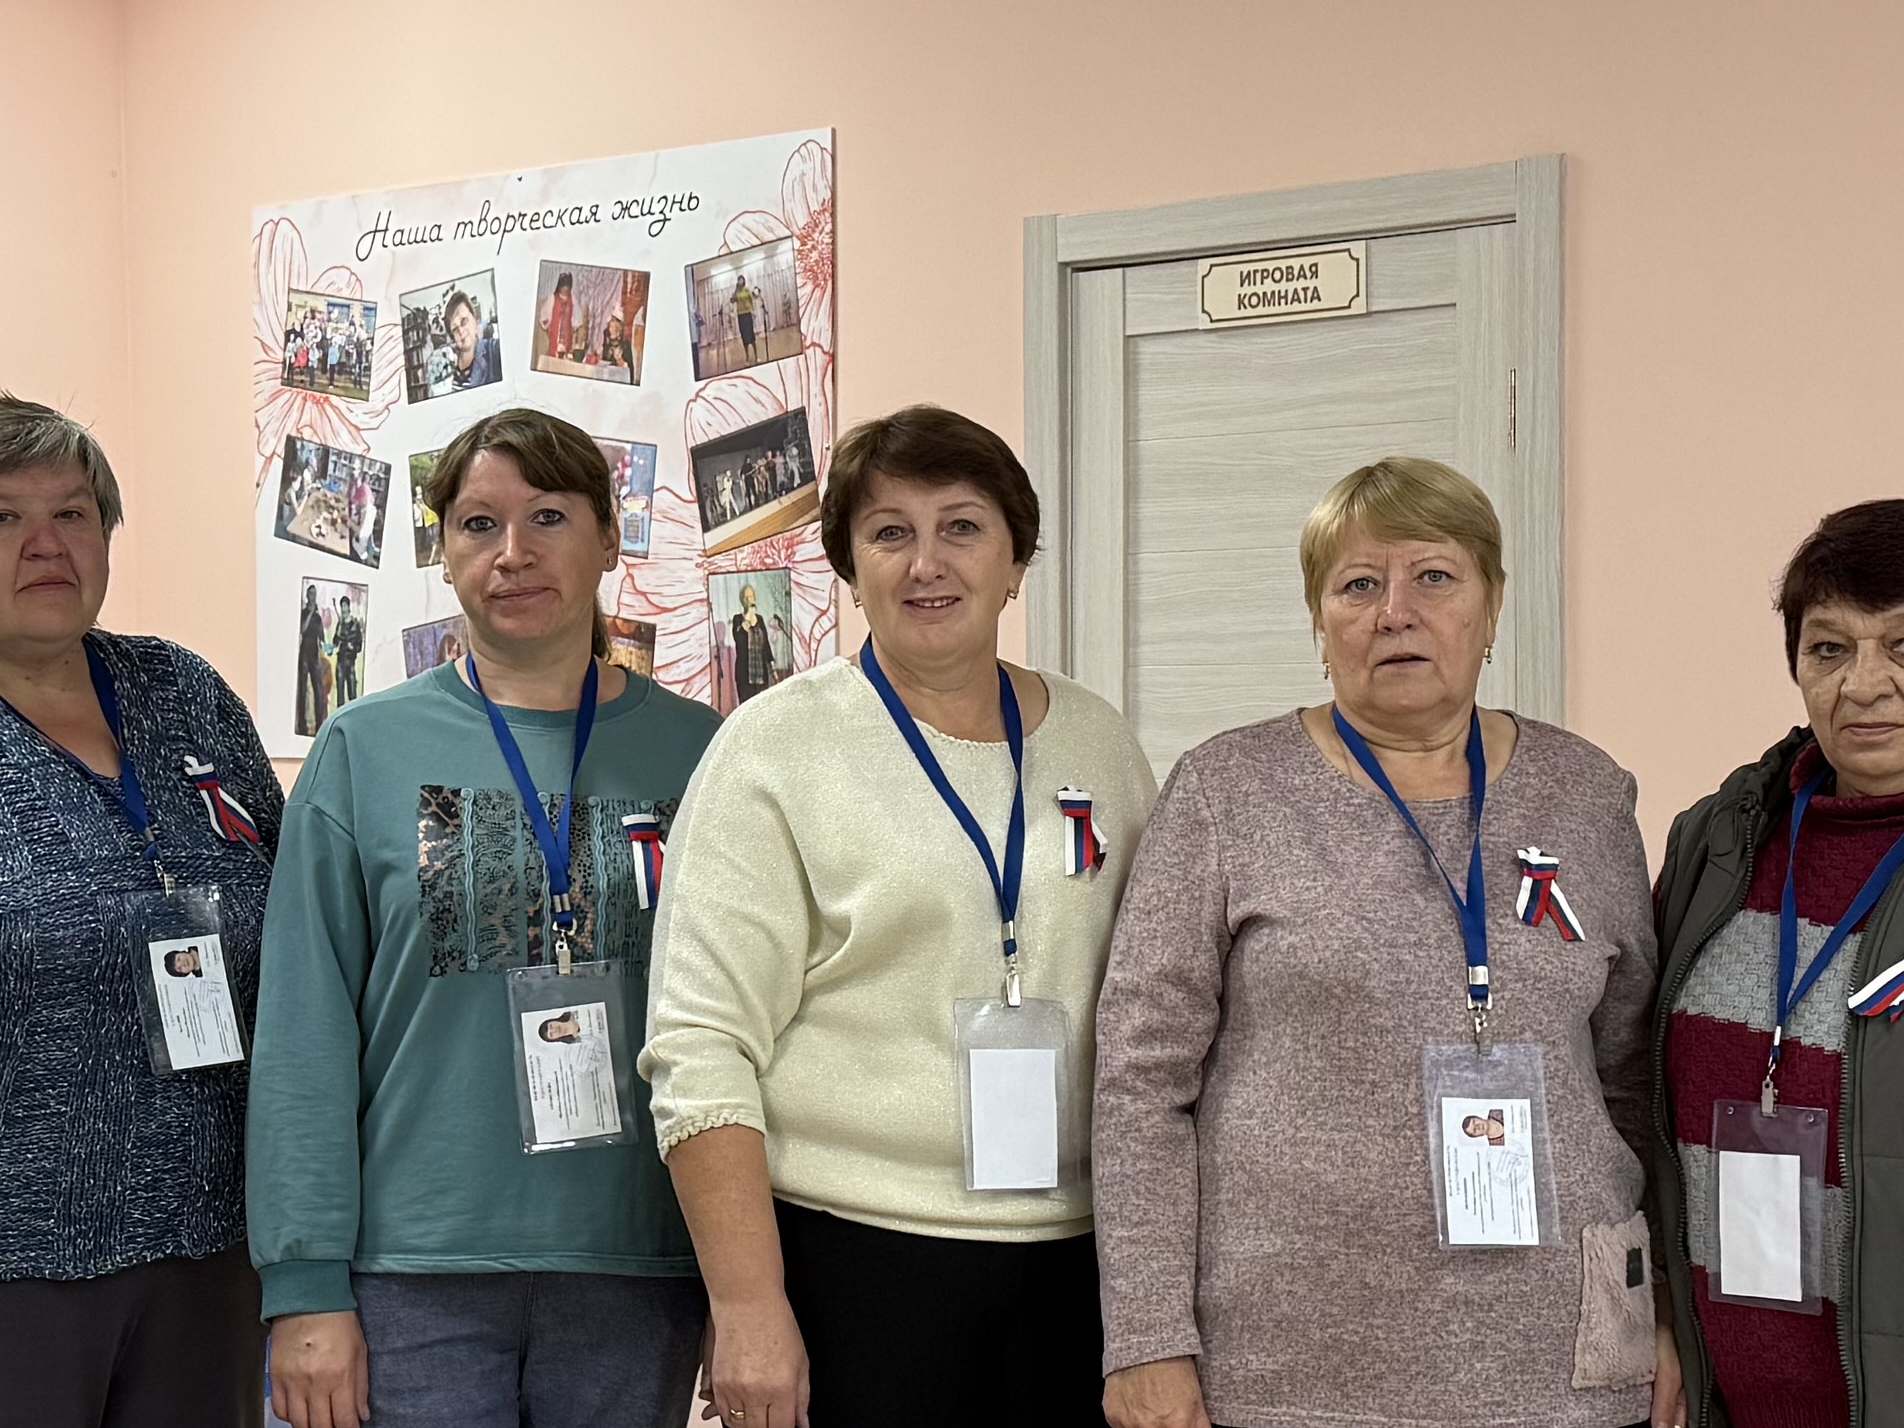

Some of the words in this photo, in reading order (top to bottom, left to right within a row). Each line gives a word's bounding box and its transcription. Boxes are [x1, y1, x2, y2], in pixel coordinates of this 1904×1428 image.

[355, 209, 443, 262] Наша
[453, 199, 601, 256] творческая
[611, 191, 700, 238] жизнь
[1239, 262, 1319, 288] ИГРОВАЯ
[1237, 285, 1322, 311] КОМНАТА
